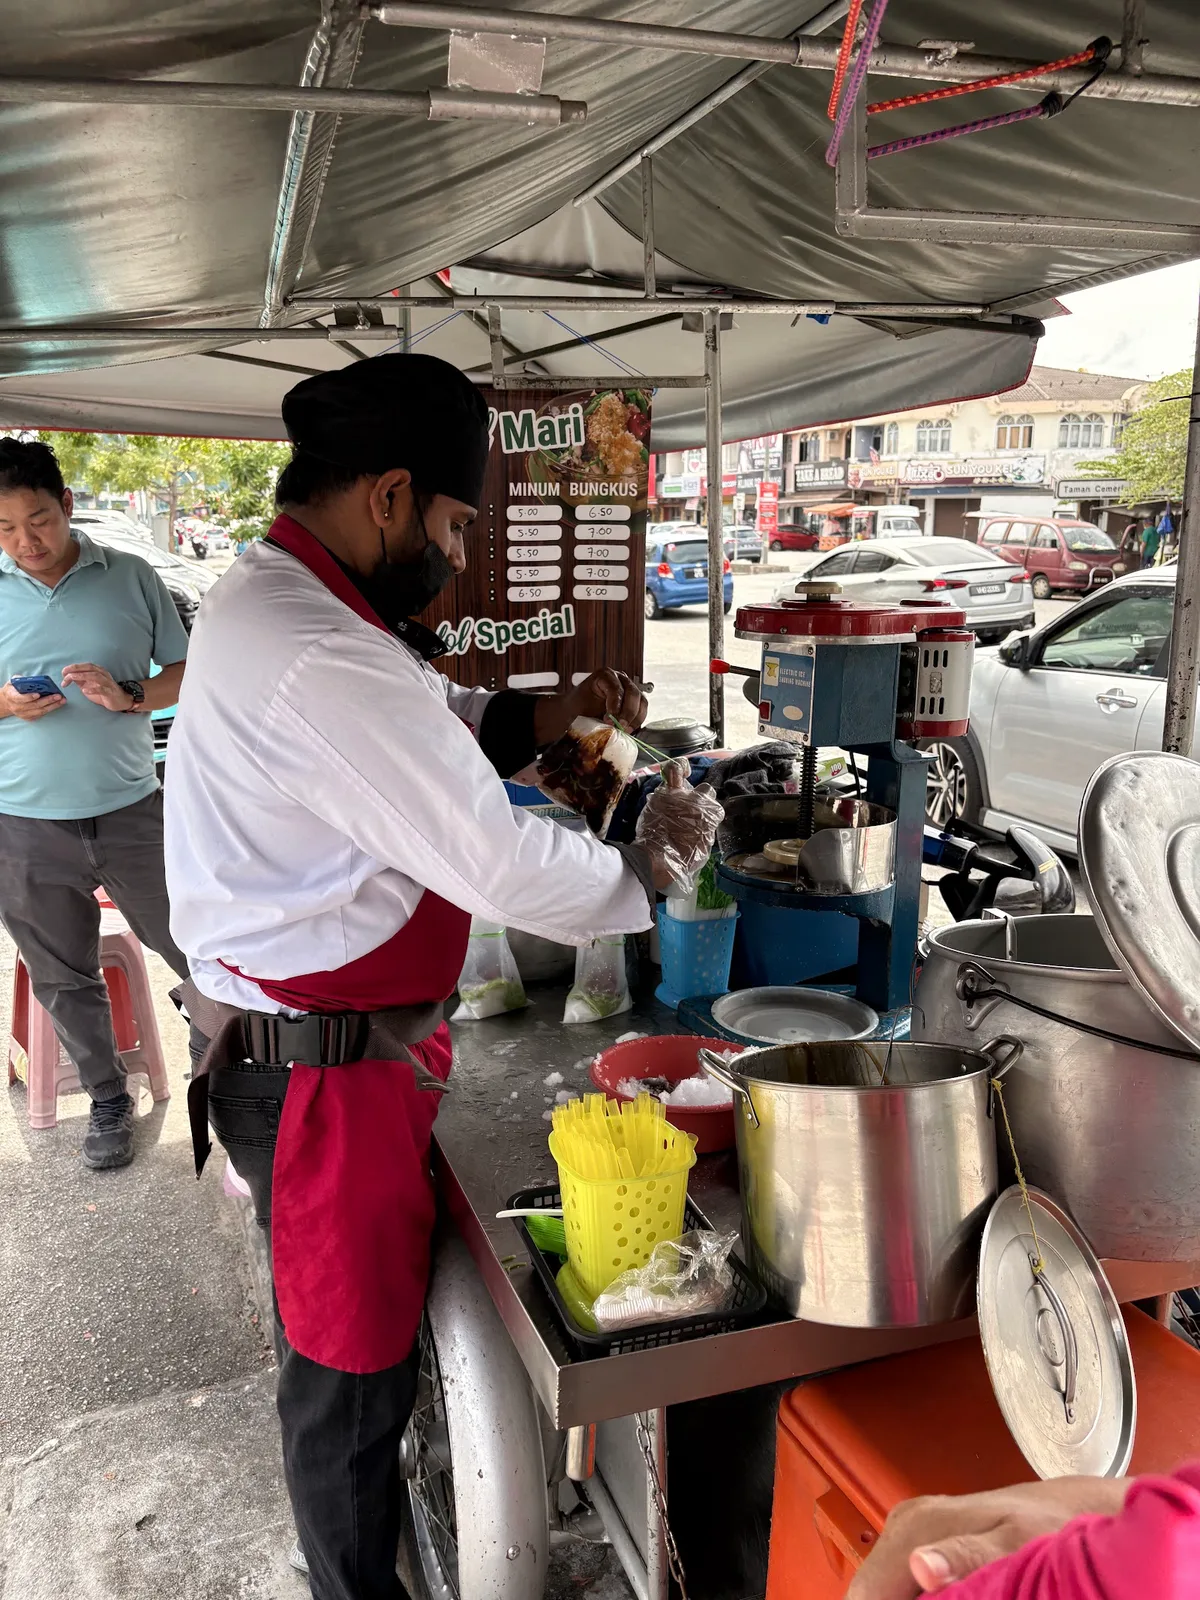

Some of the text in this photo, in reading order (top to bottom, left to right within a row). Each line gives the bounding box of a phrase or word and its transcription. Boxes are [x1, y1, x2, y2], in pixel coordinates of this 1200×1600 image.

[500, 405, 584, 453] Mari
[946, 464, 969, 476] SUN
[970, 463, 993, 475] YOU
[509, 482, 638, 497] MINUM BUNGKUS
[1064, 485, 1091, 494] Taman
[588, 507, 613, 518] 6.50
[517, 527, 613, 538] 5.50 7.00
[516, 546, 610, 558] 5.50 7.00
[515, 567, 611, 580] 5.50 7.00
[518, 586, 608, 598] 6.50 8.00
[475, 606, 573, 652] Special
[780, 668, 797, 676] ELECTRIC
[795, 679, 811, 688] MACHINE
[830, 762, 842, 771] 100
[530, 807, 560, 818] OOLER
